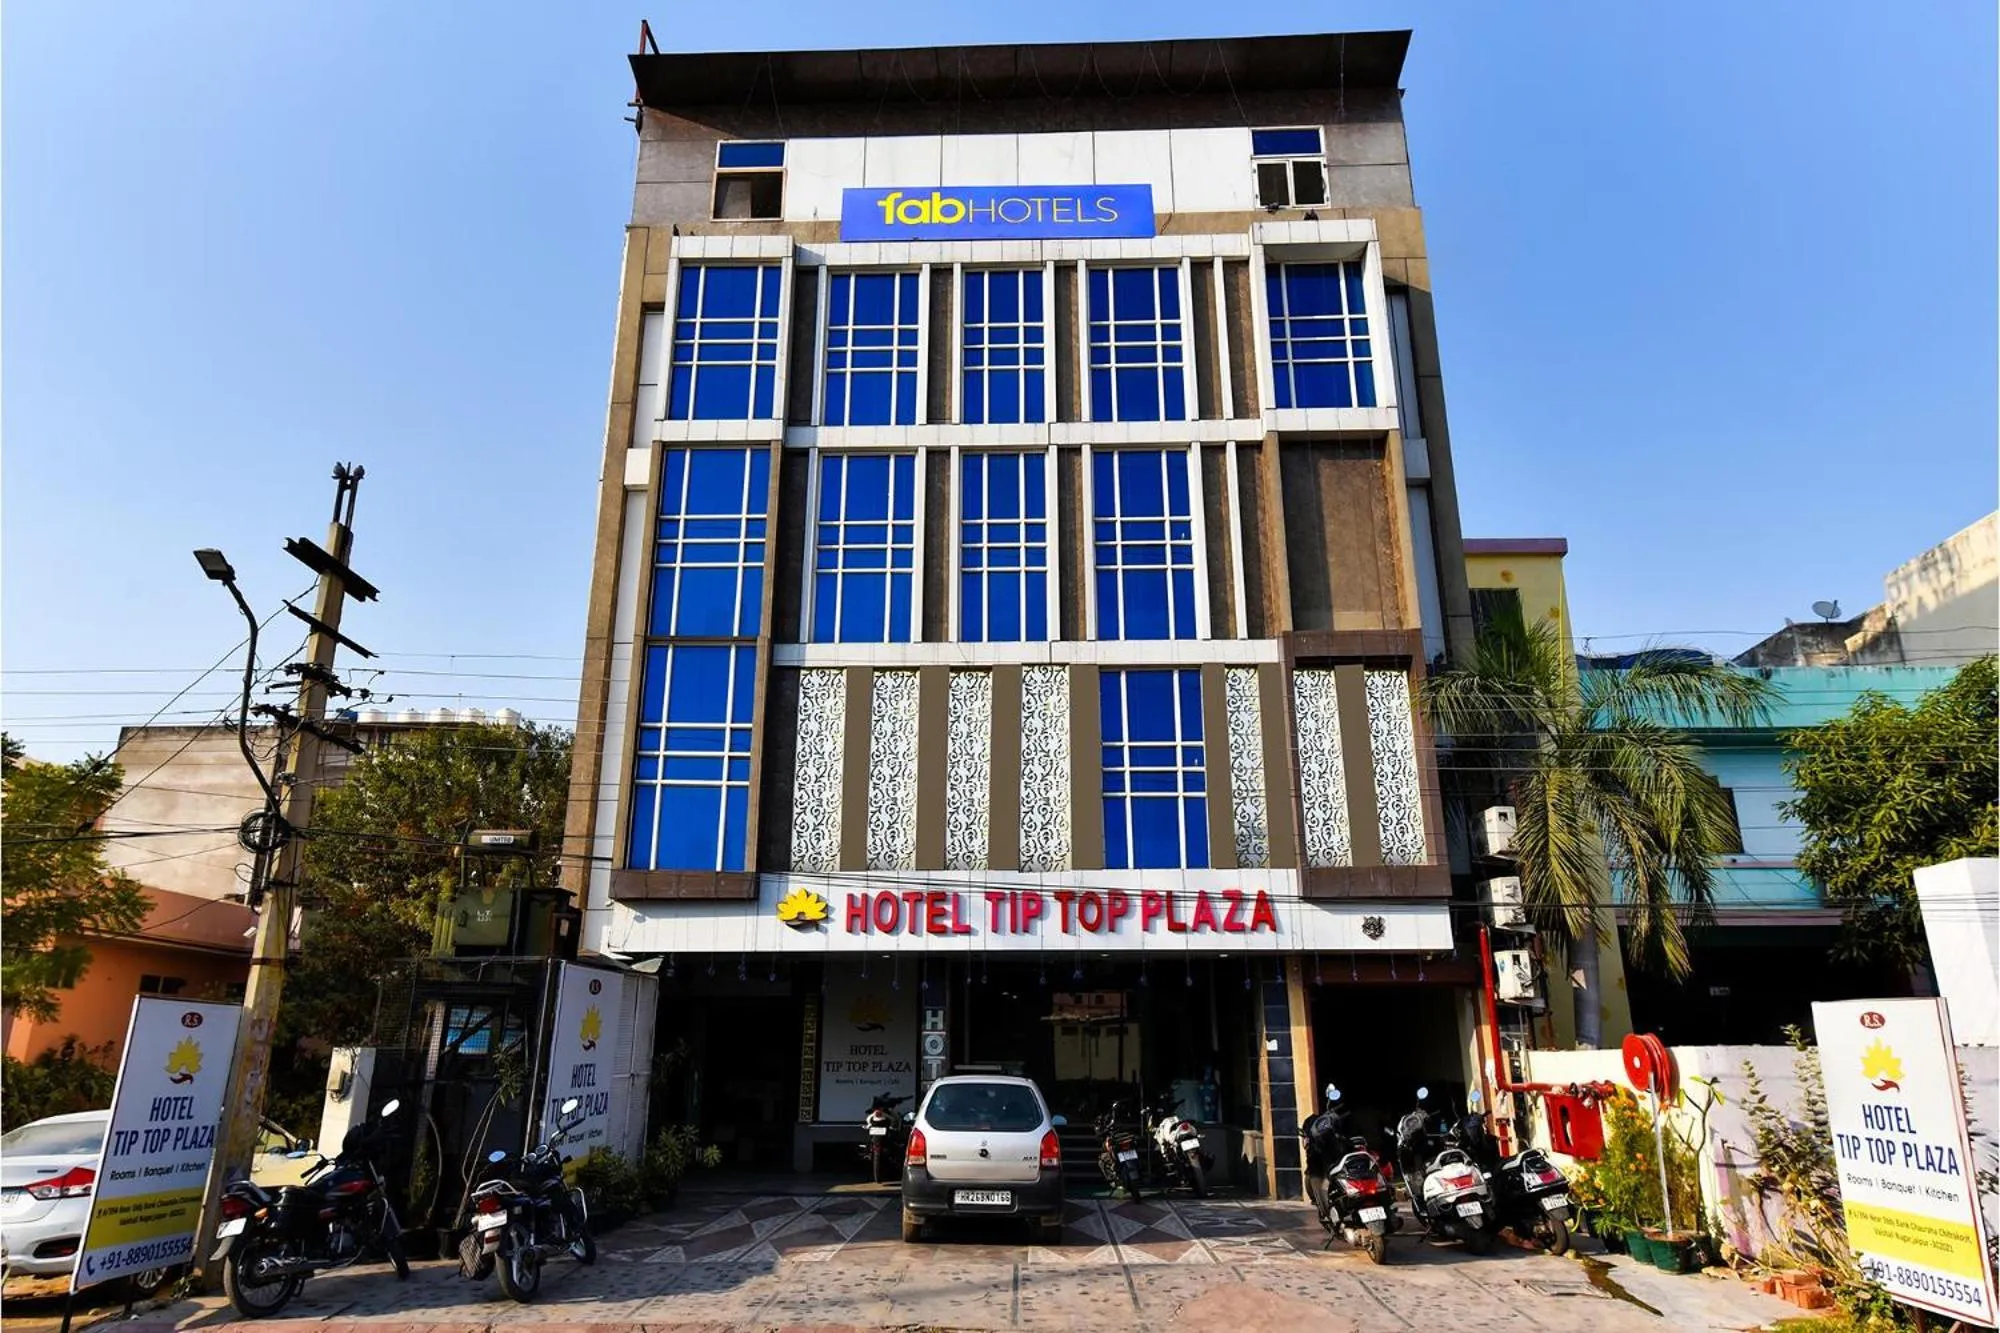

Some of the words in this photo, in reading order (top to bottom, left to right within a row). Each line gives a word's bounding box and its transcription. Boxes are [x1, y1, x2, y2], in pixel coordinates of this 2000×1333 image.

[877, 191, 1118, 225] fabHOTELS
[845, 890, 972, 937] HOTEL
[985, 891, 1042, 936] TIP
[1053, 890, 1131, 934] TOP
[1142, 889, 1277, 934] PLAZA
[850, 1044, 887, 1056] HOTEL
[571, 1063, 597, 1089] HOTEL
[824, 1061, 843, 1073] TIP
[846, 1061, 868, 1073] TOP
[872, 1061, 912, 1073] PLAZA
[149, 1096, 195, 1122] HOTEL
[584, 1091, 609, 1118] PLAZA
[1861, 1104, 1917, 1135] HOTEL
[113, 1130, 139, 1157] TIP
[142, 1128, 170, 1154] TOP
[173, 1125, 215, 1151] PLAZA
[1837, 1133, 1861, 1160] TIP
[1865, 1137, 1896, 1166] TOP
[1902, 1141, 1960, 1176] PLAZA
[110, 1169, 136, 1181] Rooms
[144, 1164, 173, 1178] Banquet
[181, 1161, 207, 1172] Kitchen
[1847, 1173, 1873, 1187] Rooms
[1882, 1178, 1916, 1195] Banquet
[1925, 1186, 1960, 1202] Kitchen
